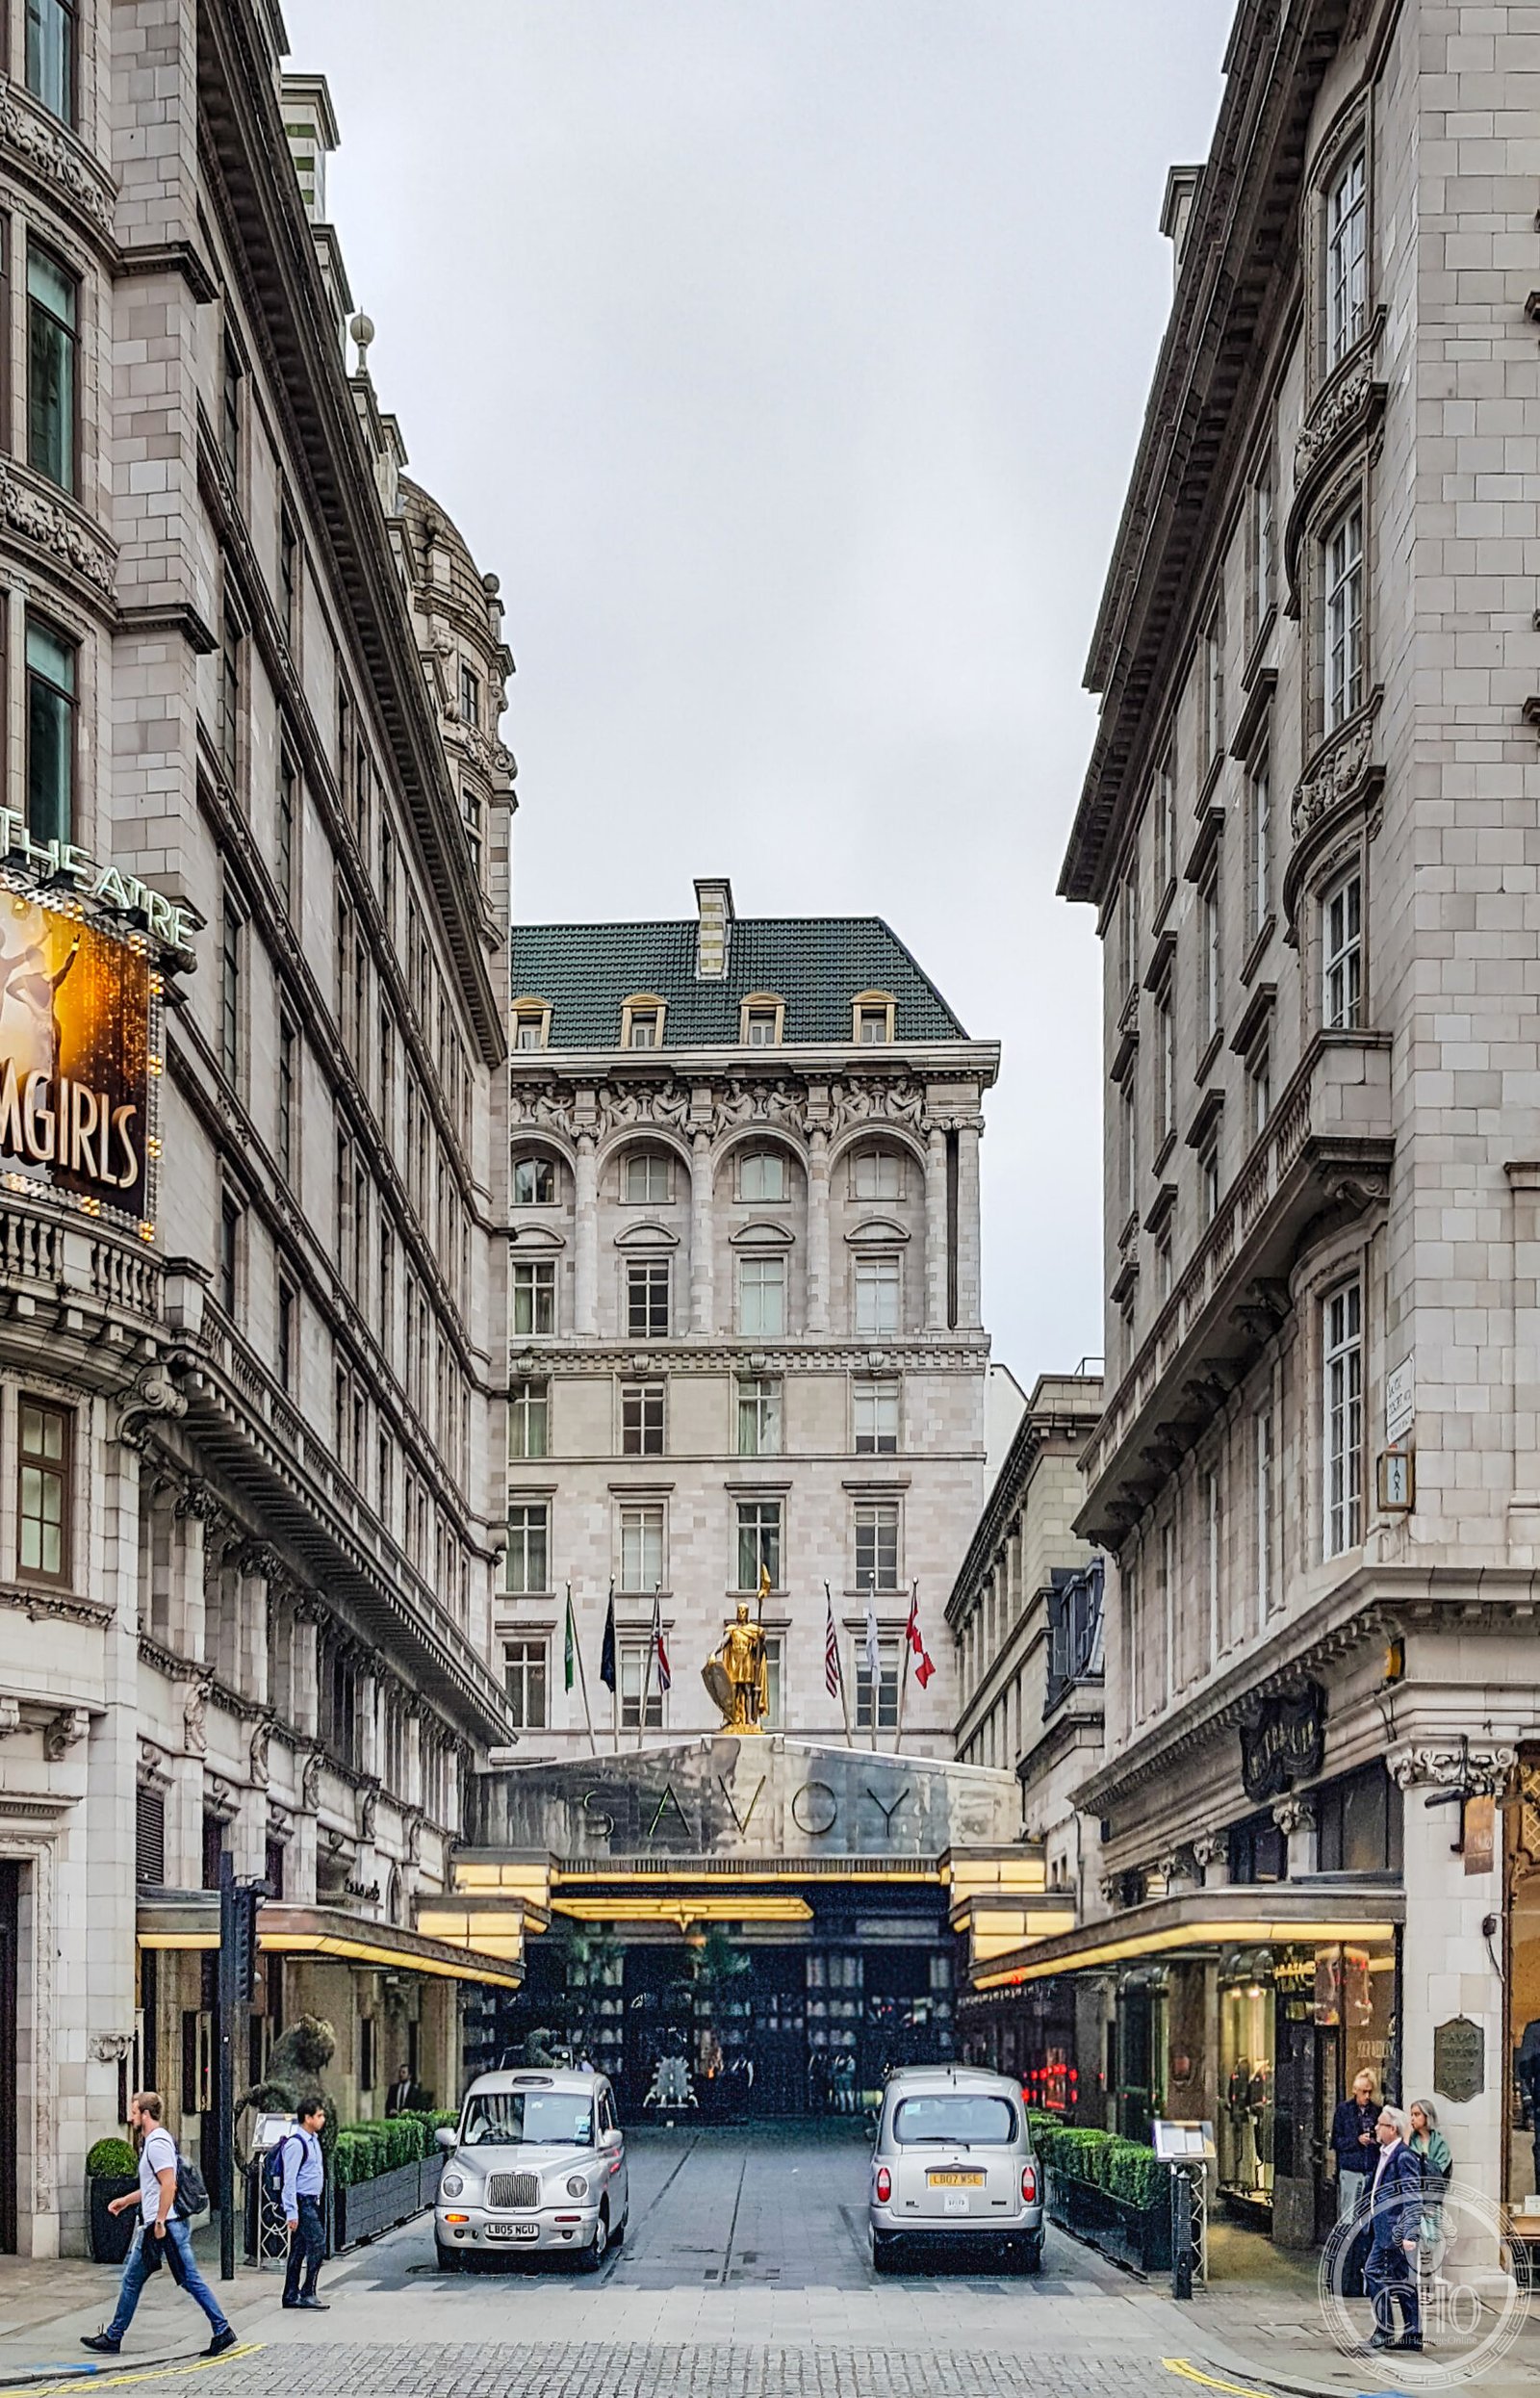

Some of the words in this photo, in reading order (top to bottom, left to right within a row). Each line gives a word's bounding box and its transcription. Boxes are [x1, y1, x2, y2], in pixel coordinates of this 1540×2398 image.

[0, 806, 196, 954] THEATRE
[582, 1774, 911, 1838] SAVOY
[488, 2224, 513, 2234] LB05
[515, 2224, 535, 2234] NGU
